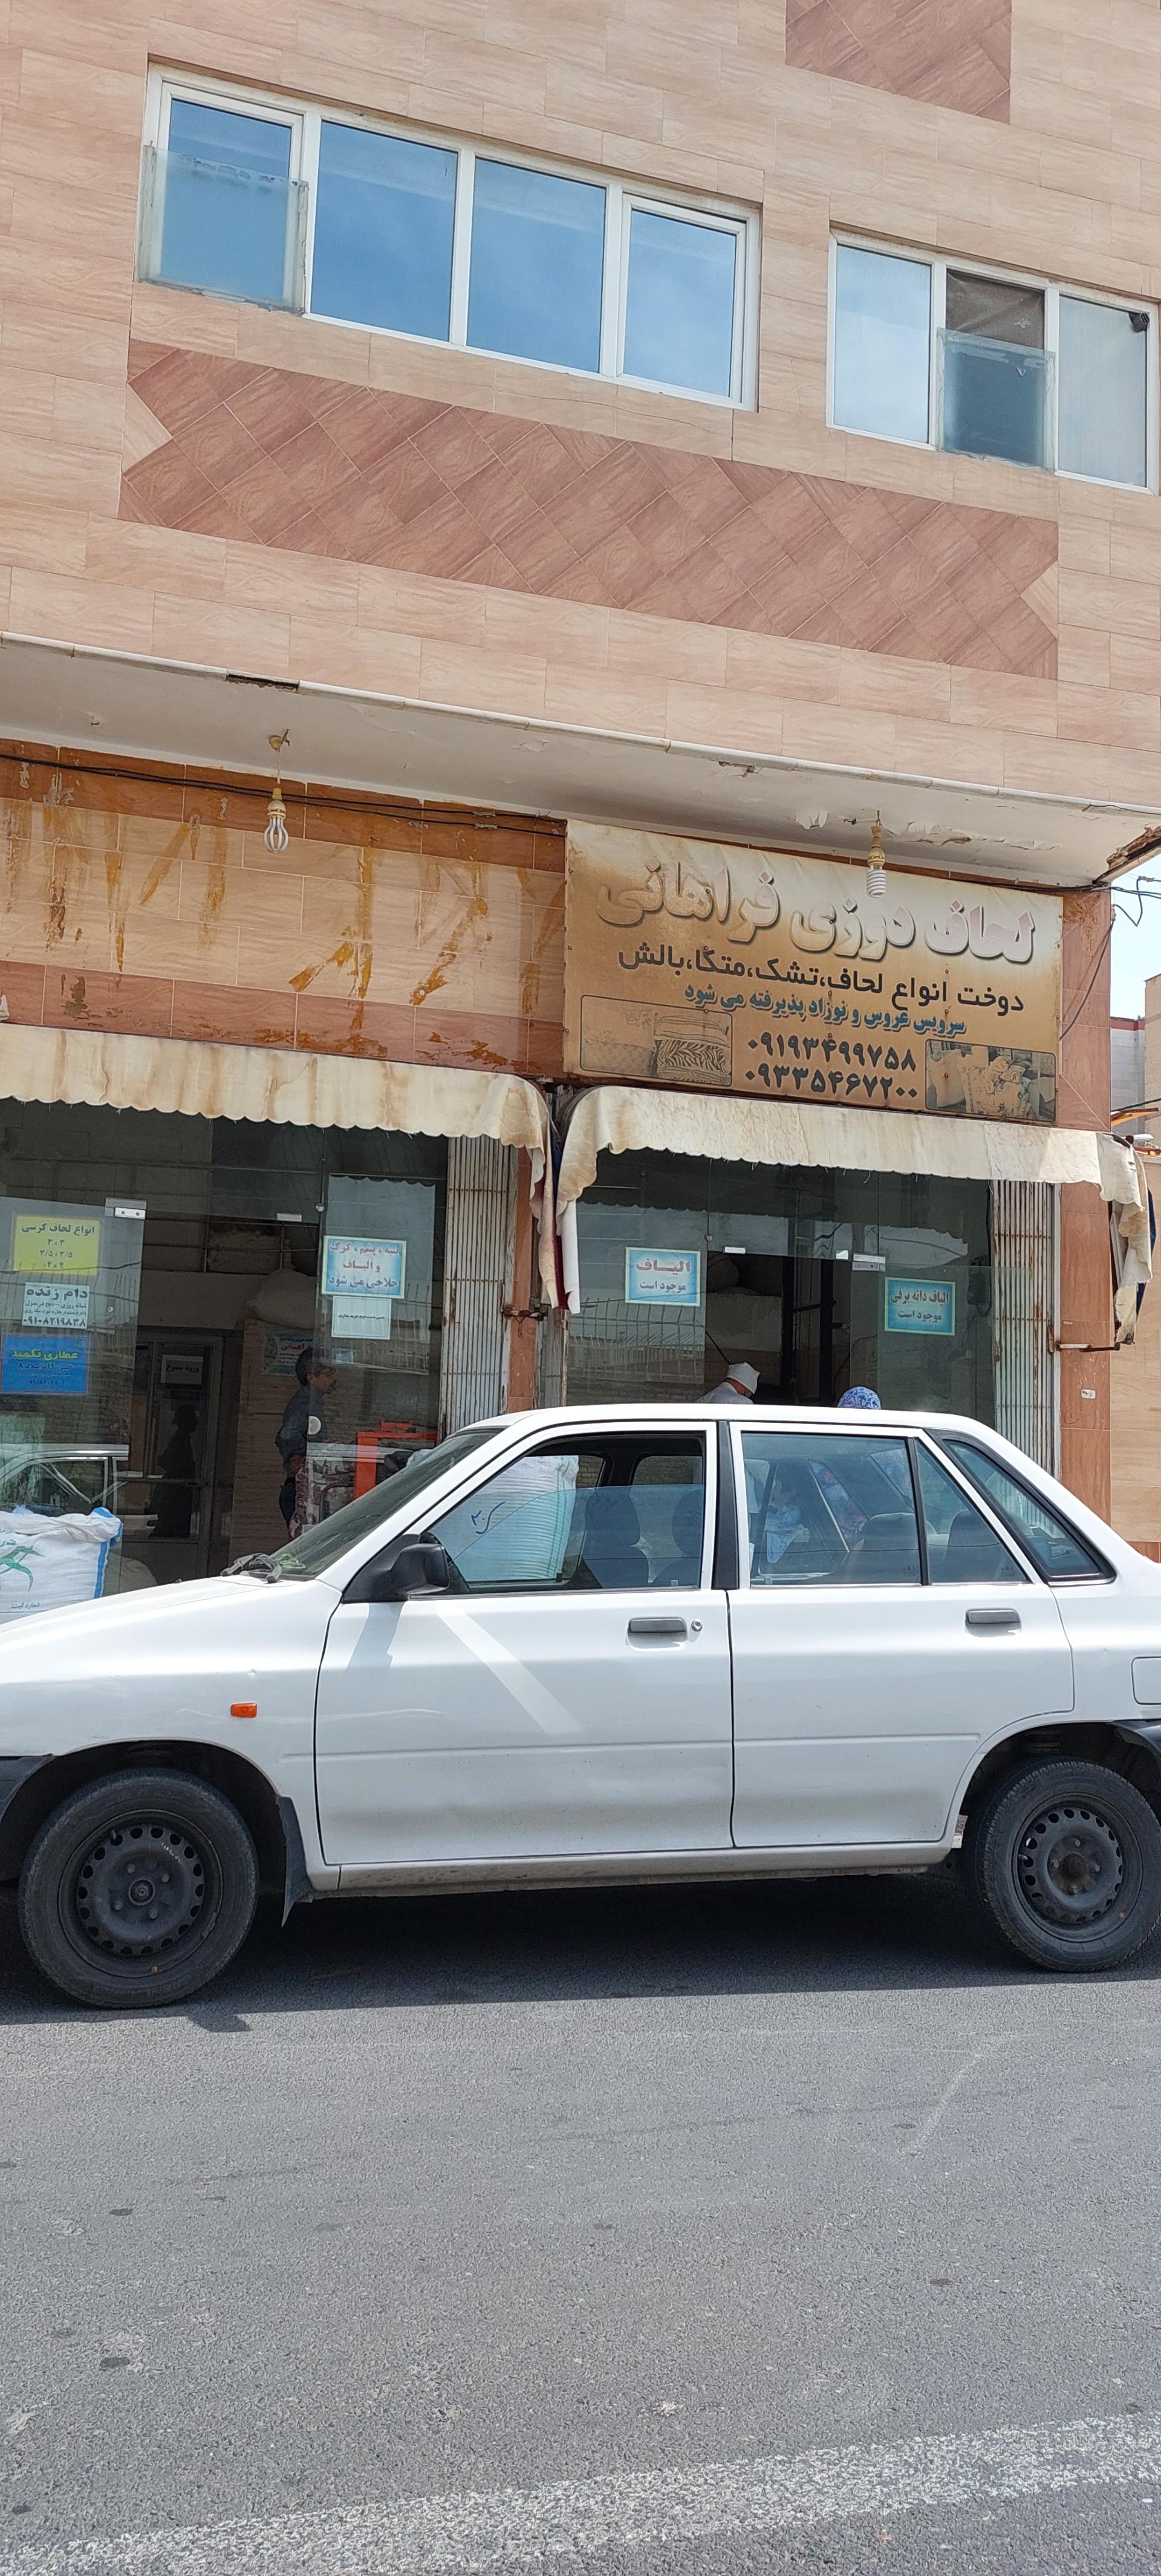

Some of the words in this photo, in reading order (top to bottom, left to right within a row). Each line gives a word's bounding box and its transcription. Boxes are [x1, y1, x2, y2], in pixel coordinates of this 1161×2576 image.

[597, 855, 781, 944] فراهانی
[789, 897, 916, 961] دوزی
[925, 899, 1035, 963] لحاف
[685, 983, 717, 1008] شود
[891, 977, 948, 1010] انواع
[957, 985, 1024, 1016] دوخت
[749, 989, 807, 1022] پذیرفته
[808, 997, 848, 1024] نوزاد
[851, 1008, 861, 1027] و
[863, 1010, 910, 1032] عروس
[913, 1015, 966, 1038] سرویس
[747, 1031, 917, 1072] ۰۹۱۹۳۴۹۹۷۵۸
[744, 1062, 918, 1100] ۰۹۳۳۵۴۶۷۲۰۰
[21, 1222, 48, 1234] کرسی
[49, 1223, 71, 1233] لحاف
[73, 1225, 95, 1236] انواع
[360, 1244, 376, 1256] پشم
[343, 1259, 373, 1272] الیاف
[374, 1264, 381, 1273] و
[636, 1258, 691, 1275] الیاف
[328, 1275, 347, 1287] شود
[350, 1279, 364, 1288] می
[366, 1277, 398, 1289] حلاجی
[640, 1280, 658, 1289] است
[660, 1281, 686, 1293] موجود
[26, 1286, 60, 1301] زنده
[63, 1287, 88, 1302] دام
[890, 1287, 911, 1304] برفی
[912, 1289, 928, 1302] دانه
[929, 1290, 949, 1306] الیاف
[897, 1309, 915, 1318] است
[917, 1312, 942, 1323] موجود
[44, 1350, 79, 1361] عطاری
